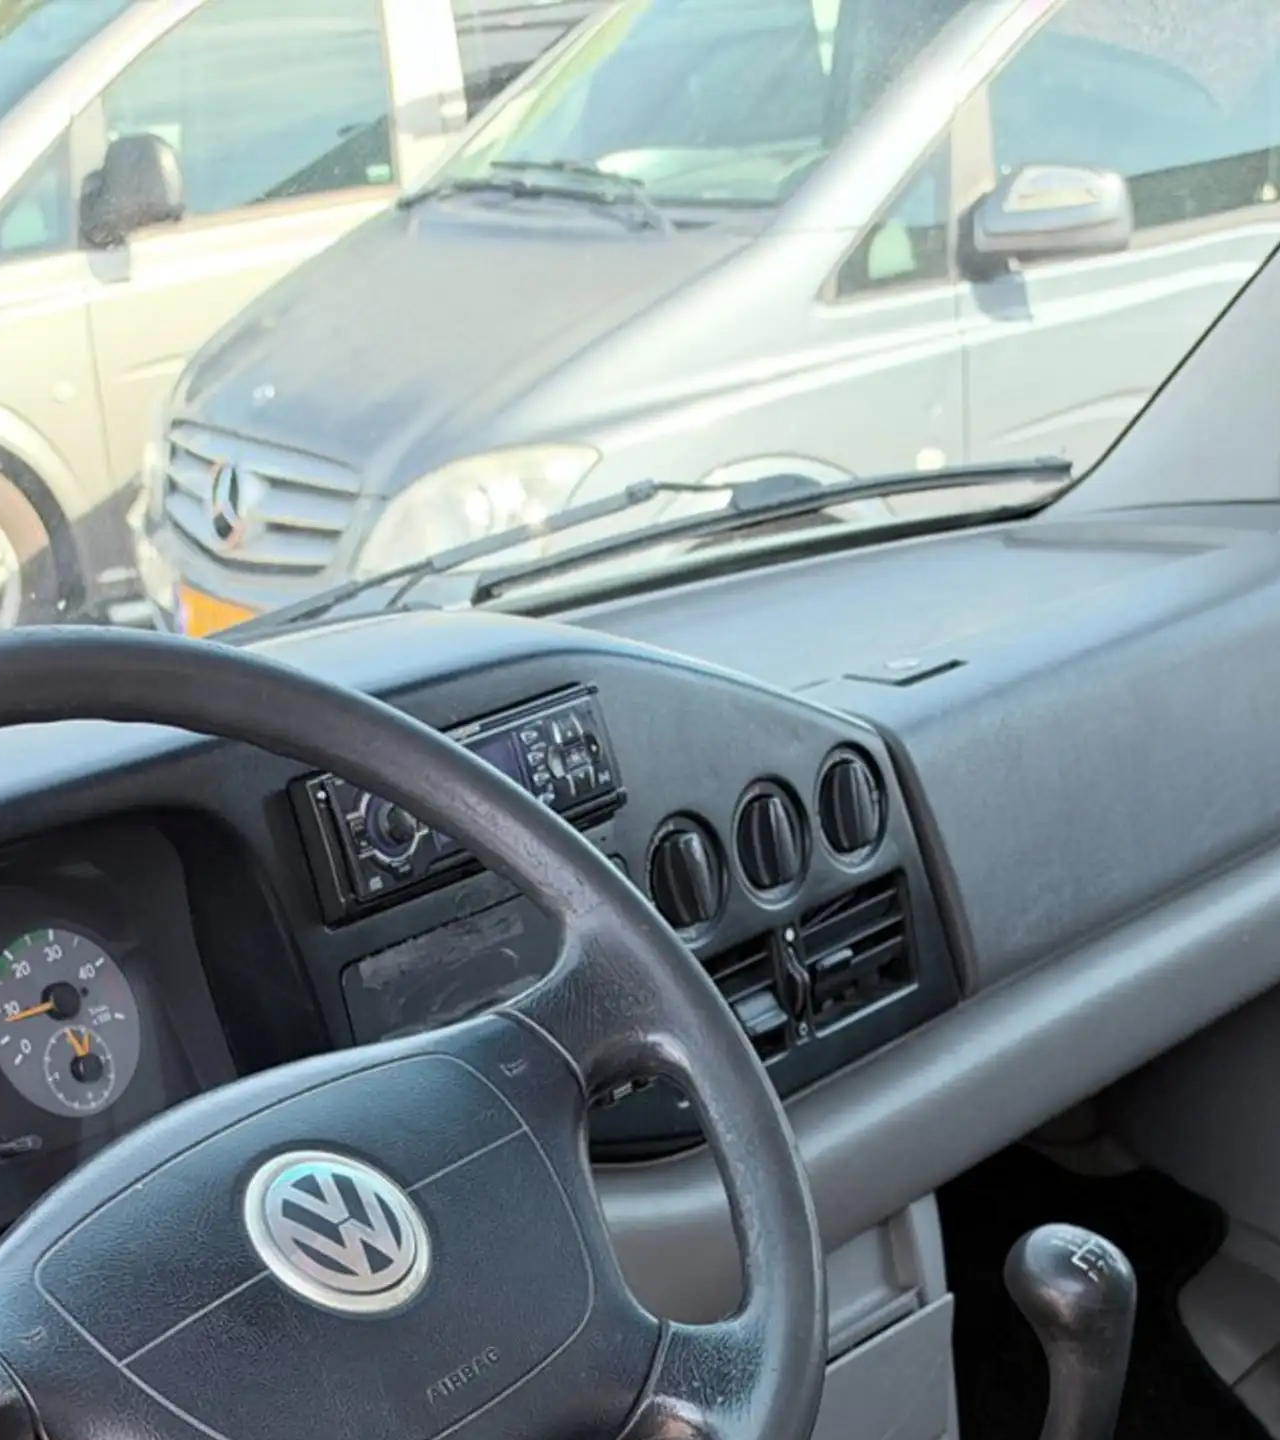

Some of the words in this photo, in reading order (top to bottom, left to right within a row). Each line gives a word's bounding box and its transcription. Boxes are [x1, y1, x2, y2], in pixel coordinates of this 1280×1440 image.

[42, 944, 63, 962] 30
[11, 960, 31, 979] 20
[78, 963, 95, 979] 40
[20, 1039, 32, 1054] 0
[425, 1345, 500, 1408] AIRBAG
